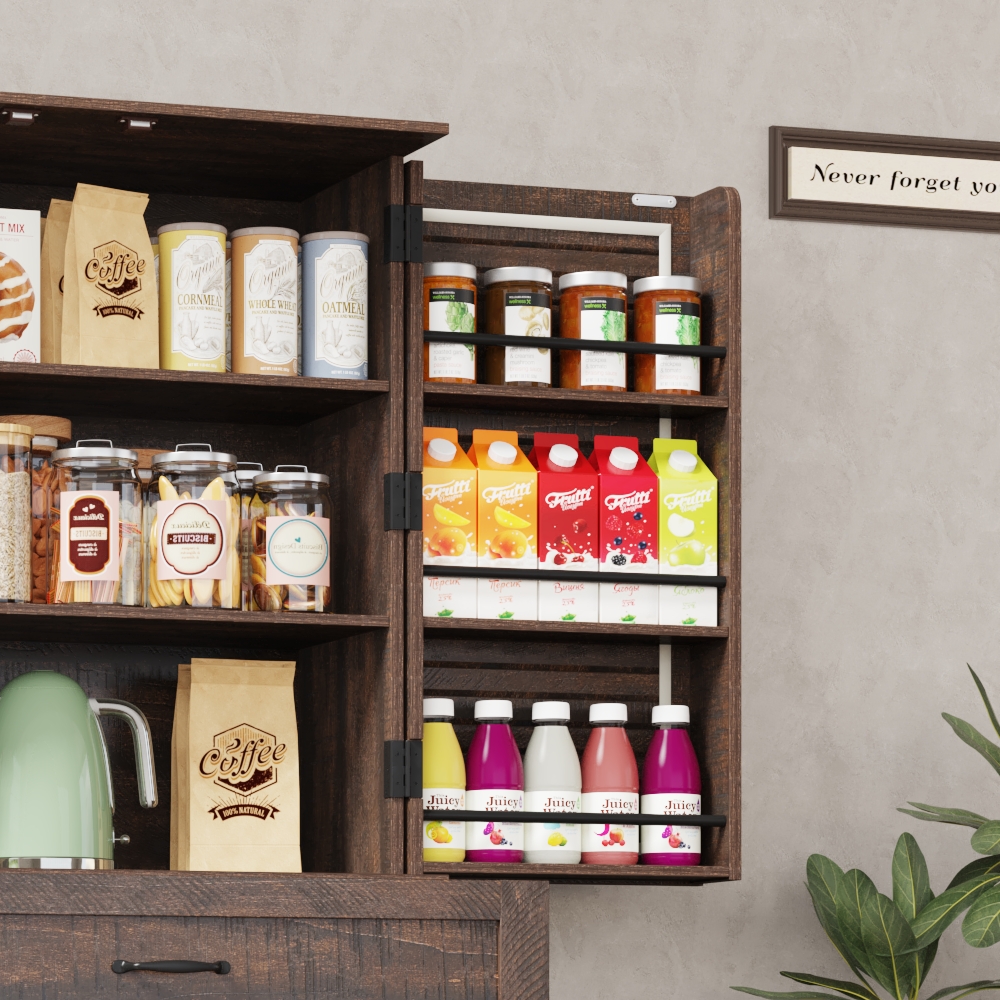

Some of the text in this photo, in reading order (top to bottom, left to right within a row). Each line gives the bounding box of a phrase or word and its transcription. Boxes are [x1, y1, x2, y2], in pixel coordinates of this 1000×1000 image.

[810, 162, 1000, 196] Never forget yo
[8, 223, 25, 233] MIX
[85, 252, 146, 283] Coffee
[177, 293, 223, 307] CORNMEAL
[247, 299, 276, 309] WHOLE
[114, 307, 134, 317] NATURAL
[322, 301, 365, 316] OATMEAL
[422, 479, 472, 500] Frutti
[482, 482, 532, 503] Frutti
[545, 488, 593, 508] Frutti
[604, 490, 652, 511] Frutti
[664, 489, 713, 510] Frutti
[199, 738, 288, 779] Coffee
[428, 795, 460, 807] Juicy
[486, 796, 519, 809] Juicy
[545, 797, 577, 810] Juicy
[602, 799, 635, 811] Juicy
[665, 800, 697, 812] Juicy
[222, 805, 266, 818] 100% NATURAL
